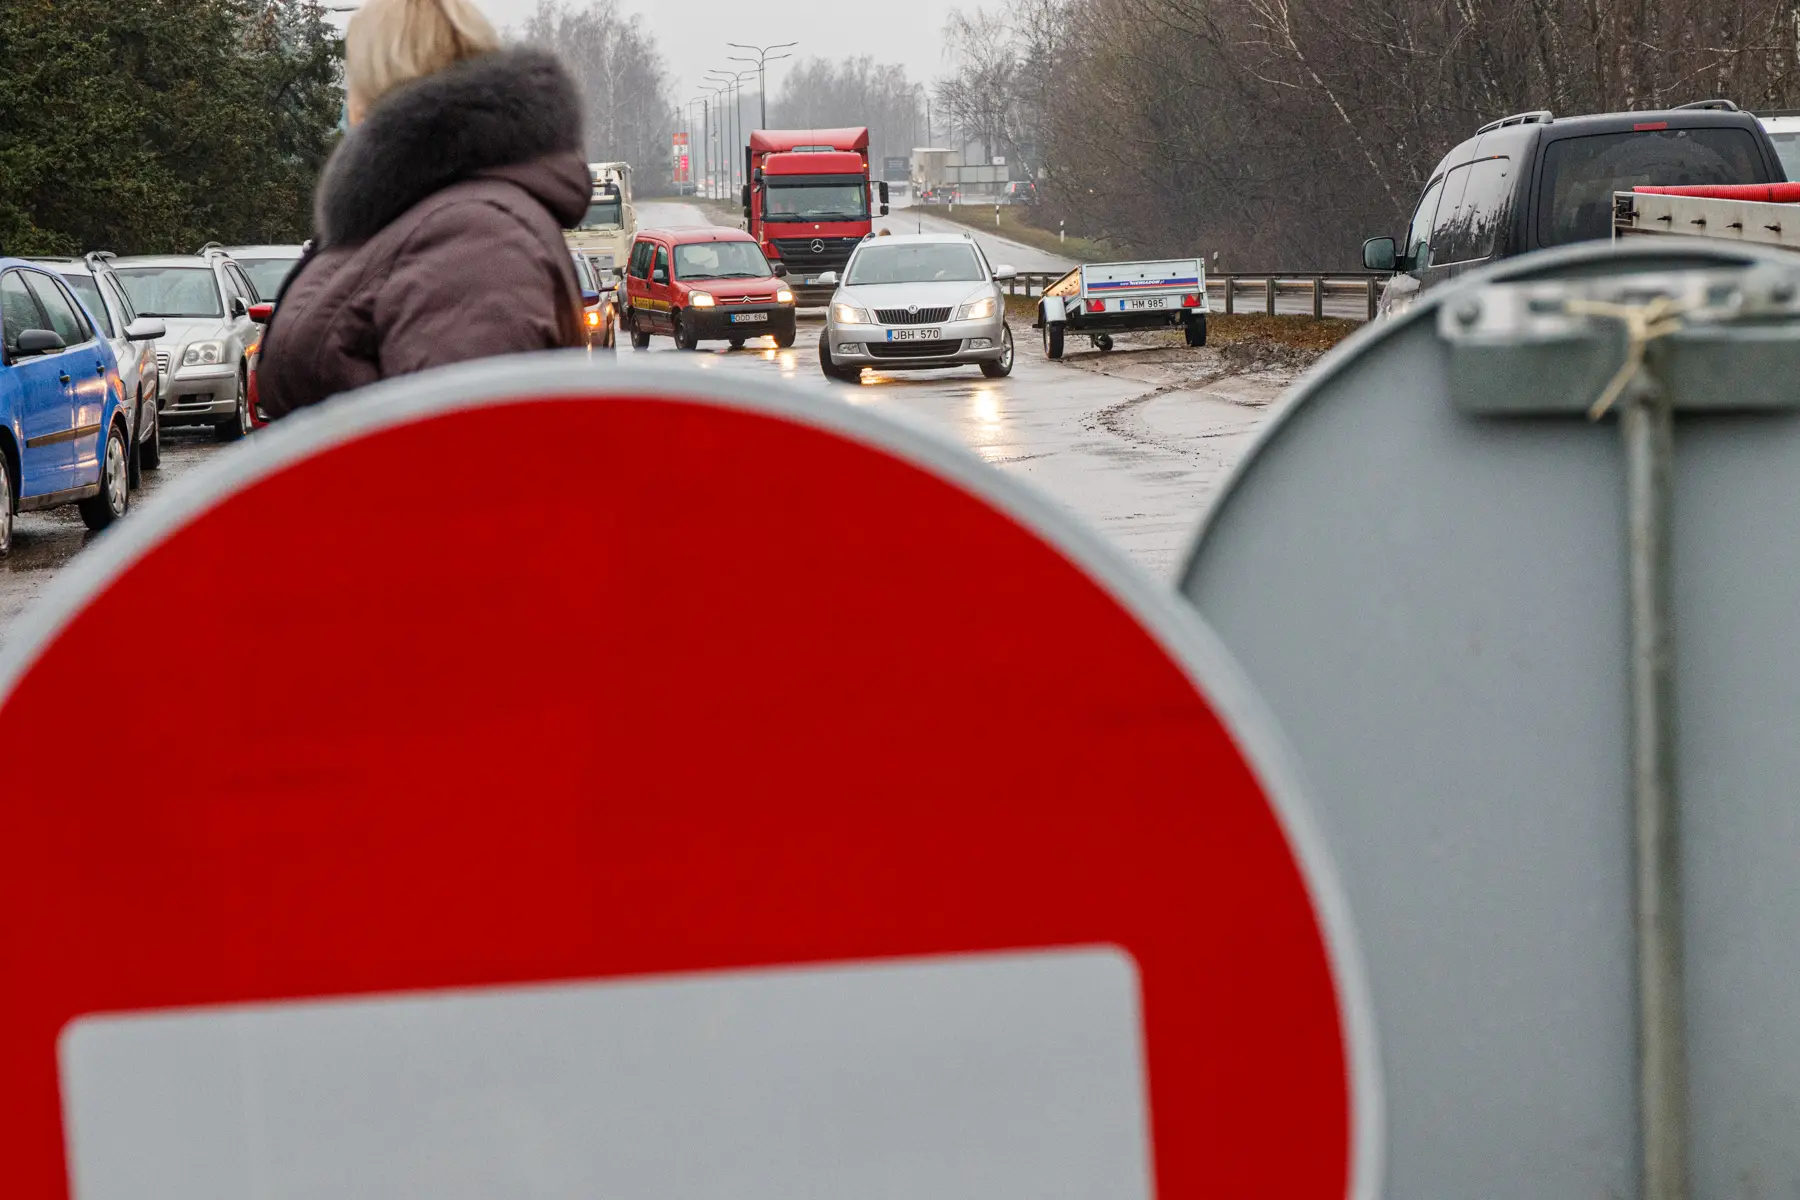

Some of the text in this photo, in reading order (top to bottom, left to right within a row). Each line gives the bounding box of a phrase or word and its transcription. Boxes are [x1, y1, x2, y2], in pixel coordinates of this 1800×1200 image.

[1132, 299, 1164, 309] HM 985
[894, 329, 939, 340] JBH 570
